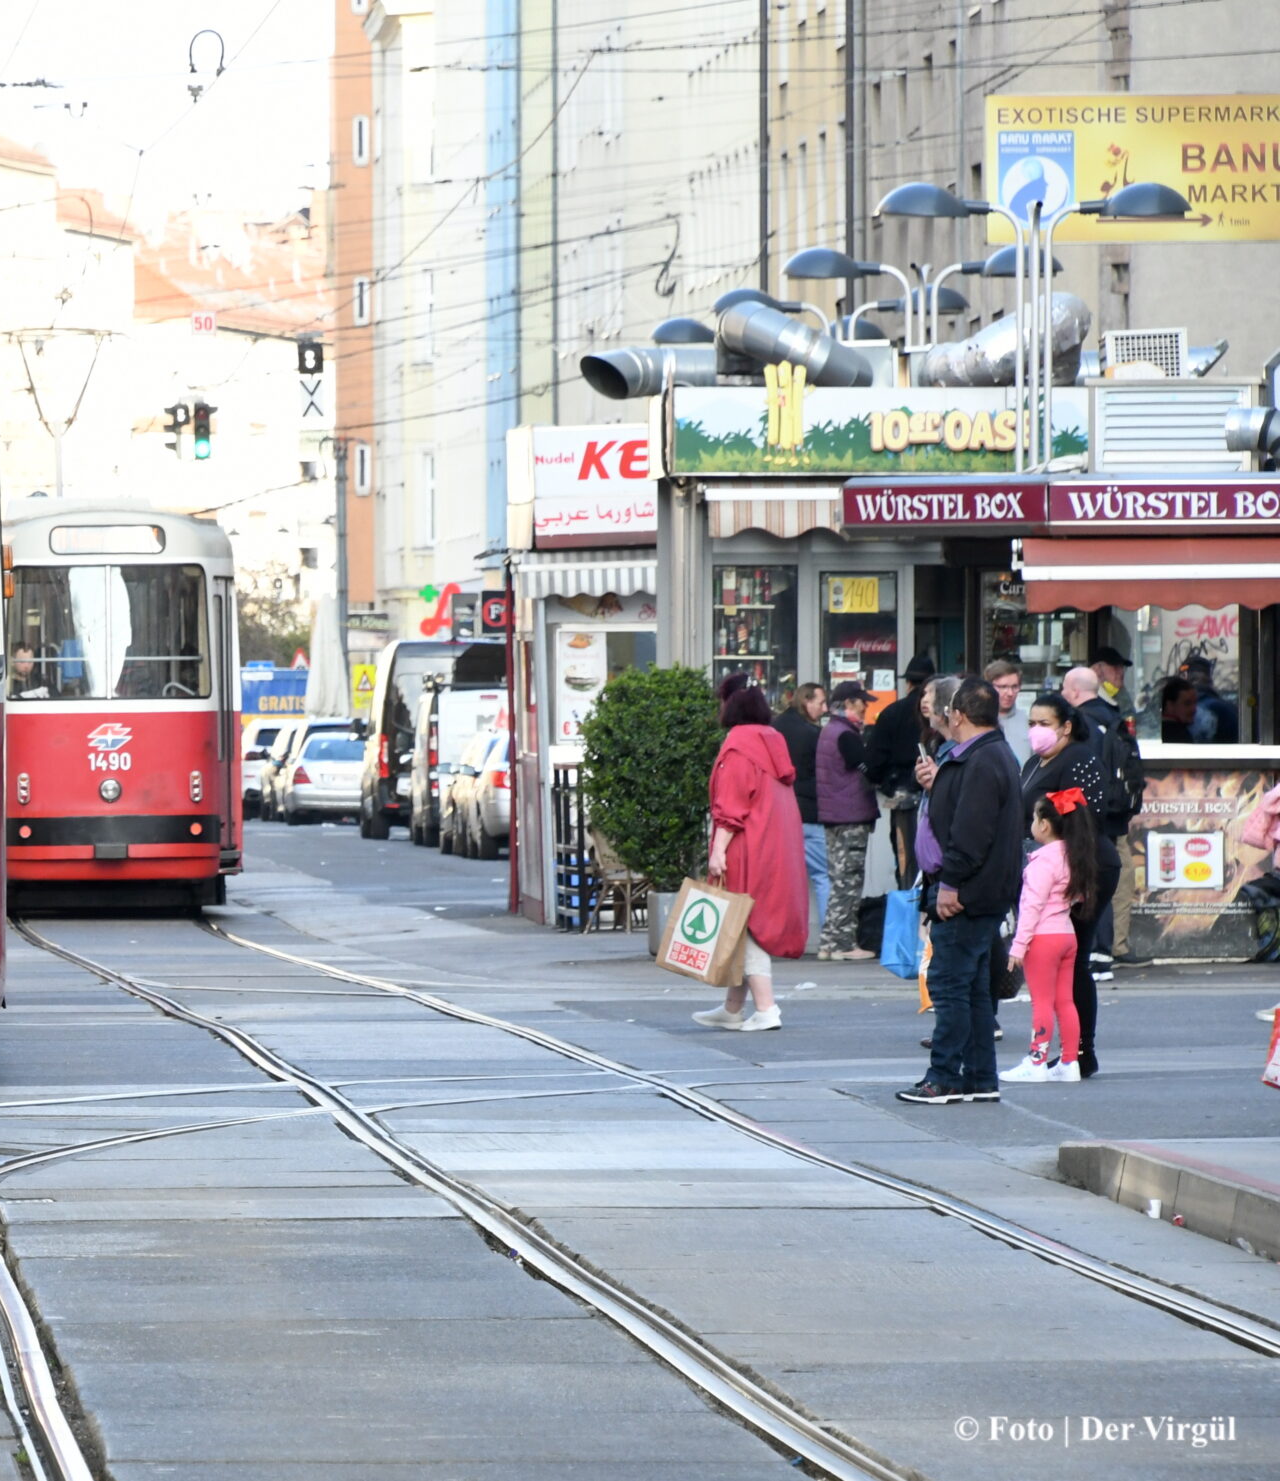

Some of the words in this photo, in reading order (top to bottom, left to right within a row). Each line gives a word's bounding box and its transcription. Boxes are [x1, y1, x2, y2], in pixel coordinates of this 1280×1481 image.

[997, 106, 1127, 124] EXOTISCHE
[1000, 132, 1029, 145] BANU
[1032, 132, 1072, 145] MARKT
[194, 316, 213, 331] 50
[869, 410, 942, 452] 10er
[535, 452, 575, 465] Nudel
[596, 501, 655, 524] شاورما
[855, 490, 970, 522] WÜRSTEL
[975, 491, 1025, 520] BOX
[1068, 486, 1227, 520] WÜRSTEL
[1233, 490, 1280, 518] BO
[535, 509, 589, 531] عربي
[87, 752, 132, 771] 1490
[1204, 802, 1232, 814] BOX
[669, 950, 705, 970] SPAR
